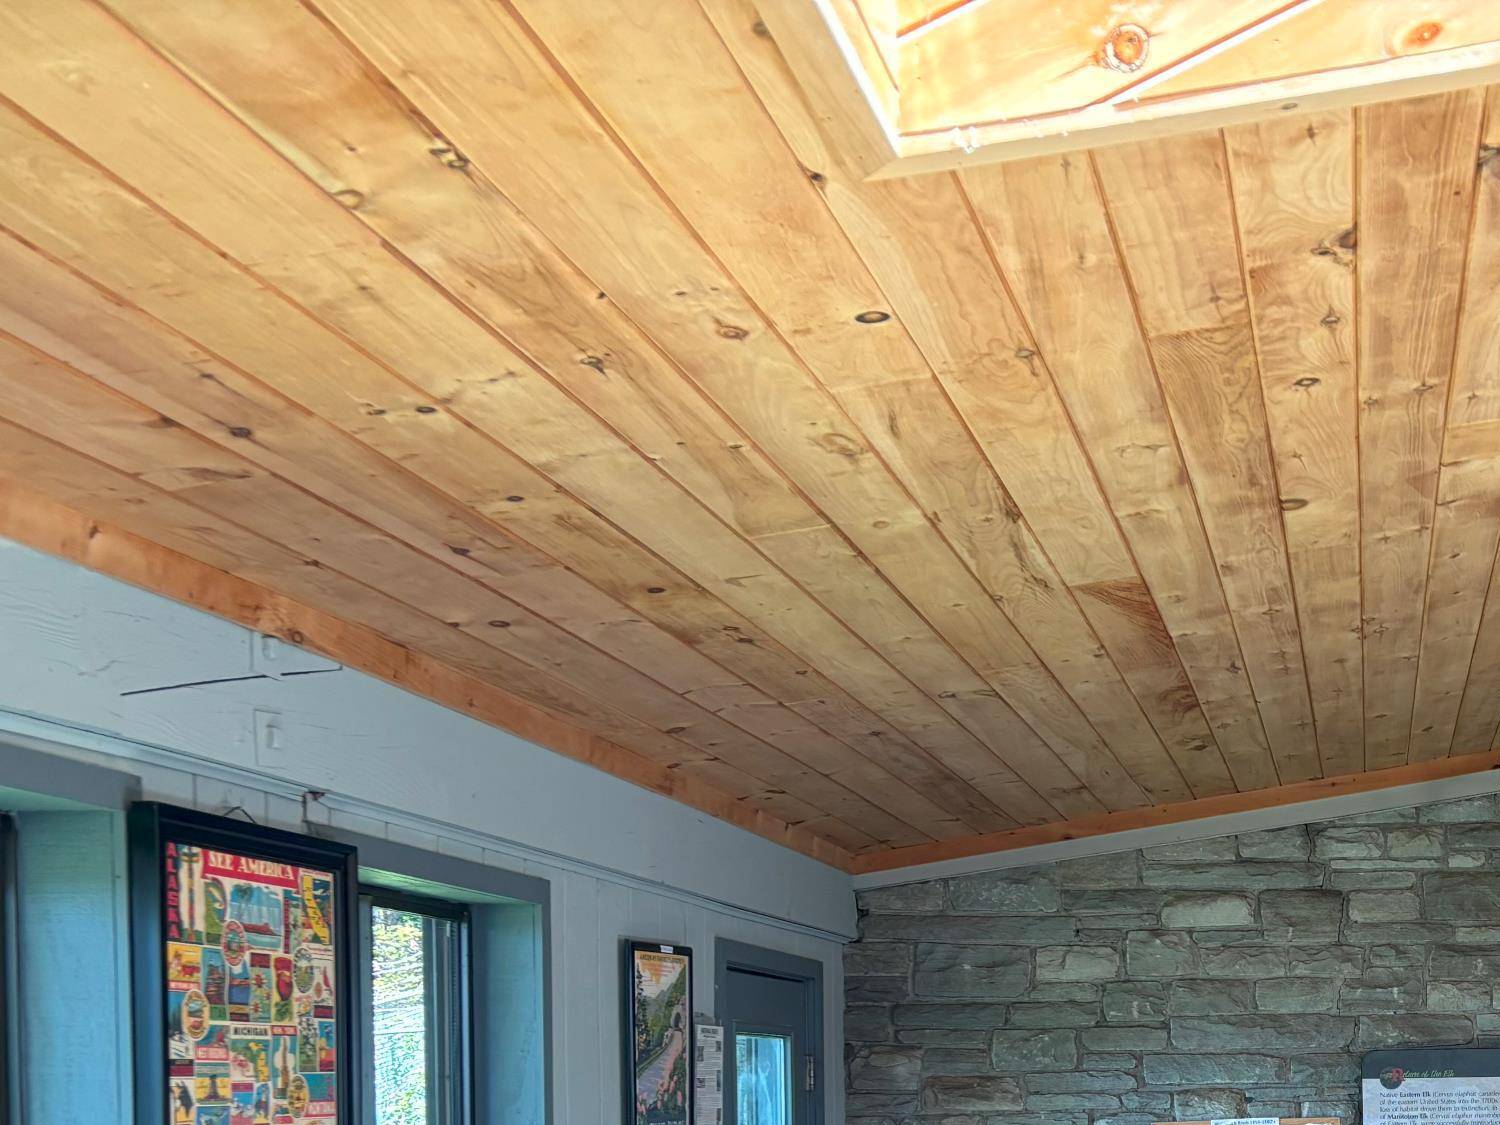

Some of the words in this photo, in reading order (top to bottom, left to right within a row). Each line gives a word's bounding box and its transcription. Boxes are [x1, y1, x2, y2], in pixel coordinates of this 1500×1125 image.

[209, 852, 234, 868] SEE
[239, 857, 294, 879] AMERICA
[167, 842, 180, 938] ALASKA
[234, 1027, 268, 1036] MICHIGAN
